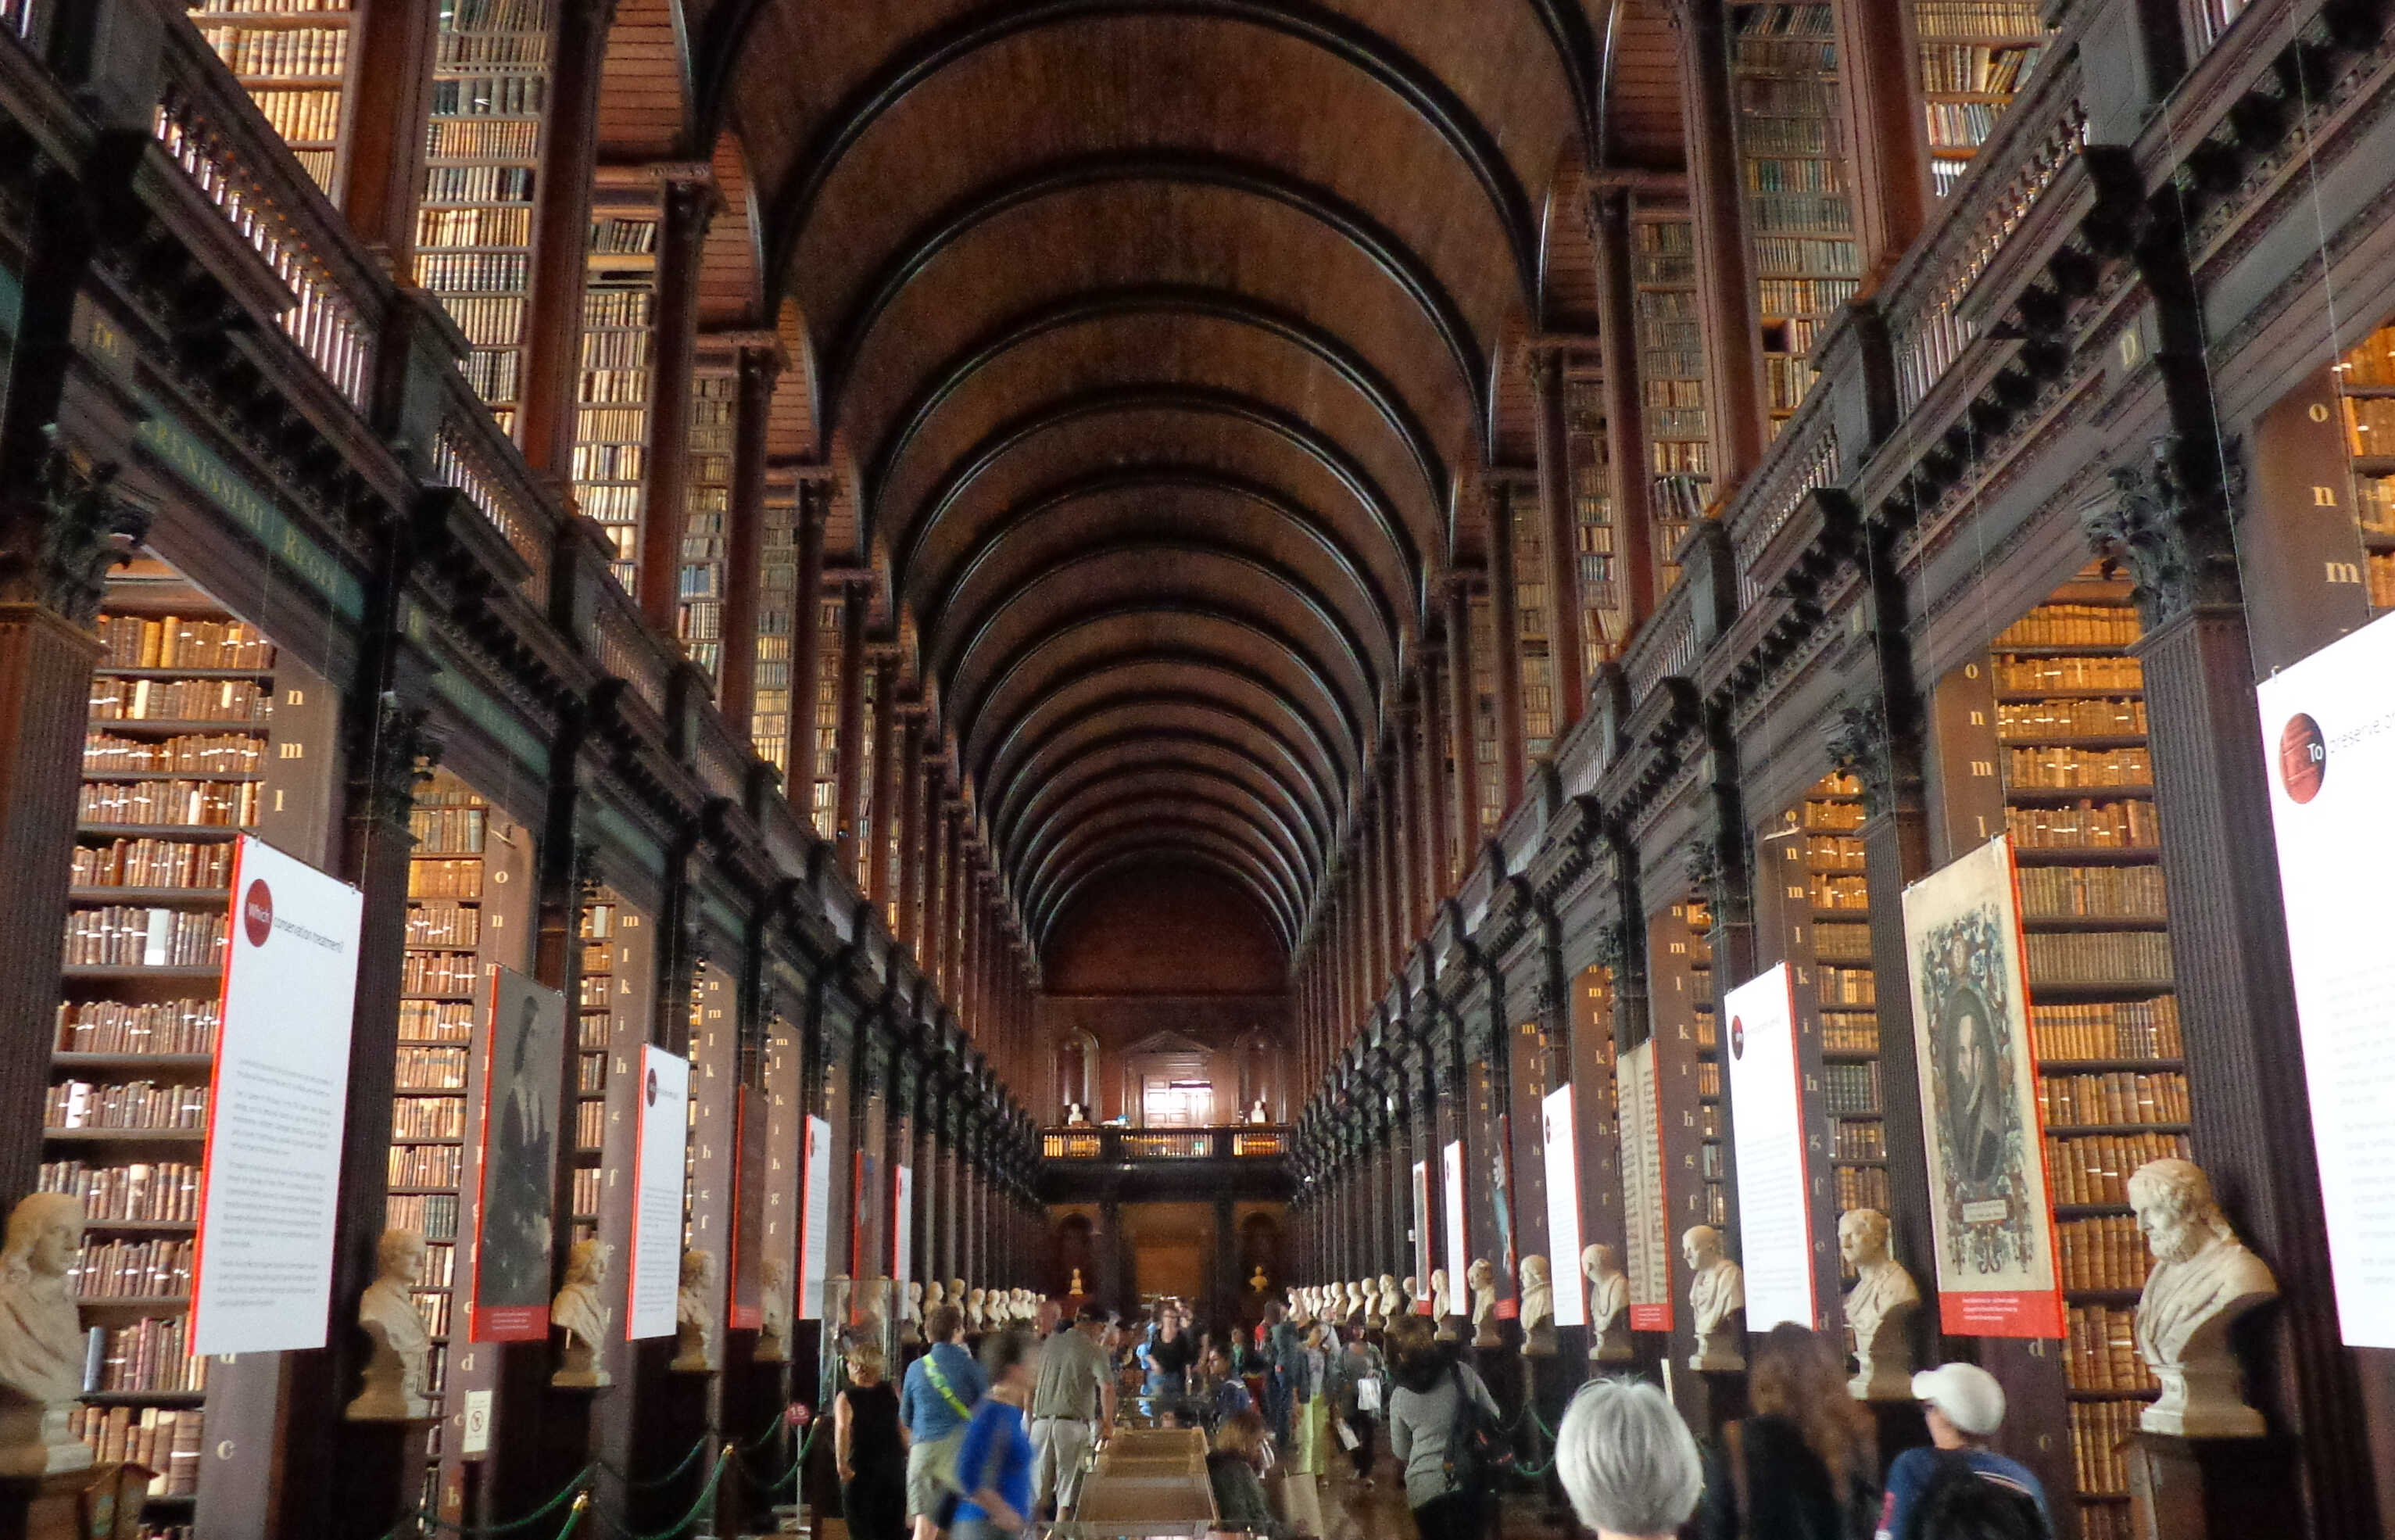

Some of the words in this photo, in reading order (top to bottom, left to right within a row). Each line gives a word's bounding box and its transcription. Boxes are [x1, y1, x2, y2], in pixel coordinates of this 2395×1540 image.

[2120, 333, 2136, 366] D
[2308, 403, 2329, 423] o
[2312, 485, 2338, 507] n
[2325, 561, 2361, 584] m
[1965, 663, 1979, 679] o
[287, 689, 303, 705] n
[1970, 711, 1986, 725] n
[2307, 743, 2324, 763] To
[2329, 719, 2381, 755] preserve
[280, 743, 304, 759] m
[1970, 761, 1993, 776] m
[274, 790, 284, 811] l
[1785, 810, 1797, 821] o
[1976, 815, 1987, 838] l
[1785, 847, 1798, 860] n
[494, 870, 509, 884] o
[1787, 886, 1804, 898] m
[249, 902, 270, 924] What
[1671, 905, 1683, 917] n
[491, 914, 503, 928] n
[622, 915, 639, 927] m
[1794, 926, 1801, 944] l
[622, 947, 629, 963] l
[1670, 942, 1686, 954] m
[1796, 966, 1810, 984] k
[621, 979, 632, 994] k
[709, 981, 719, 991] n
[1676, 976, 1682, 991] l
[1588, 987, 1602, 997] m
[708, 1008, 721, 1019] m
[1521, 1023, 1536, 1034] m
[1677, 1024, 1691, 1040] k
[775, 1039, 789, 1048] m
[1596, 1050, 1606, 1064] k
[616, 1057, 627, 1074] h
[707, 1064, 714, 1077] k
[1529, 1083, 1538, 1094] k
[1806, 1074, 1818, 1092] h
[775, 1094, 784, 1107] k
[1684, 1110, 1695, 1127] h
[1809, 1134, 1821, 1152] g
[703, 1144, 711, 1159] h
[771, 1156, 781, 1171] h
[1684, 1154, 1695, 1169] g
[608, 1167, 619, 1187] f
[1814, 1176, 1824, 1196] f
[1819, 1311, 1830, 1330] d
[2028, 1337, 2046, 1358] d
[460, 1352, 475, 1371] d
[217, 1438, 236, 1461] c
[447, 1485, 461, 1507] b
